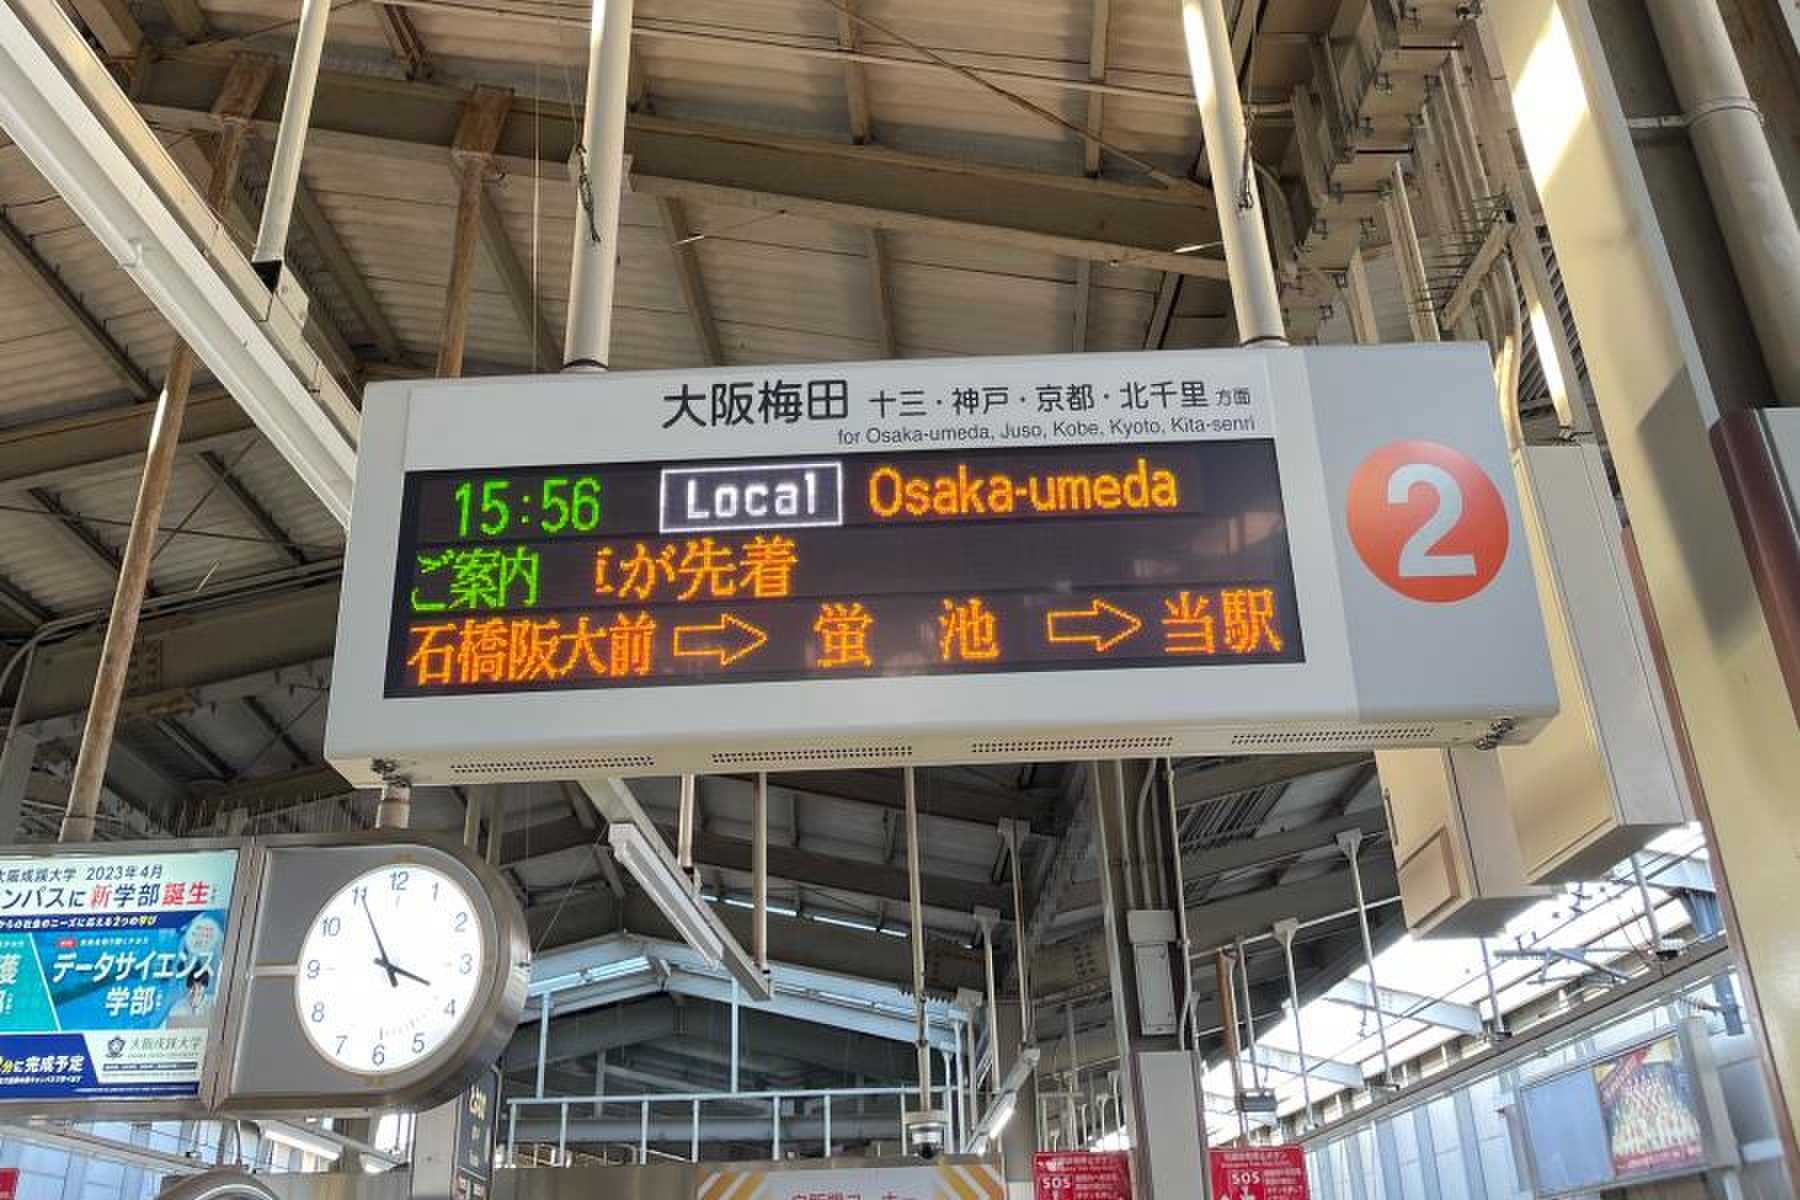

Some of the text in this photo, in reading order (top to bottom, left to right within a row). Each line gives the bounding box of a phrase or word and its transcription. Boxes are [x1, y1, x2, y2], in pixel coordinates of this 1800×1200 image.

[662, 379, 848, 428] 大阪梅田
[1216, 387, 1250, 406] 方面
[838, 416, 1256, 444] for Osaka-umeda, Juso, Kobe, Kyoto, Kita-senri
[455, 459, 1178, 537] 15:56 Local Osaka-umeda
[1387, 463, 1478, 577] 2
[411, 546, 540, 612] ご案内
[407, 611, 656, 686] 石橋阪大前
[1162, 588, 1282, 655] 当駅
[86, 864, 163, 880] 2023年4月
[389, 871, 410, 891] 12
[352, 887, 369, 906] 11
[432, 882, 441, 901] 1
[321, 917, 341, 937] 10
[454, 912, 468, 932] 2
[53, 951, 215, 984] データサイエンス
[307, 960, 320, 978] 9
[459, 954, 473, 974] 3
[105, 985, 156, 1017] 学部
[444, 999, 456, 1018] 4
[312, 1002, 325, 1023] 8
[335, 1036, 348, 1055] 7
[412, 1033, 425, 1053] 5
[372, 1045, 385, 1066] 6
[1042, 1177, 1071, 1189] SOS
[1232, 1171, 1260, 1185] SOS
